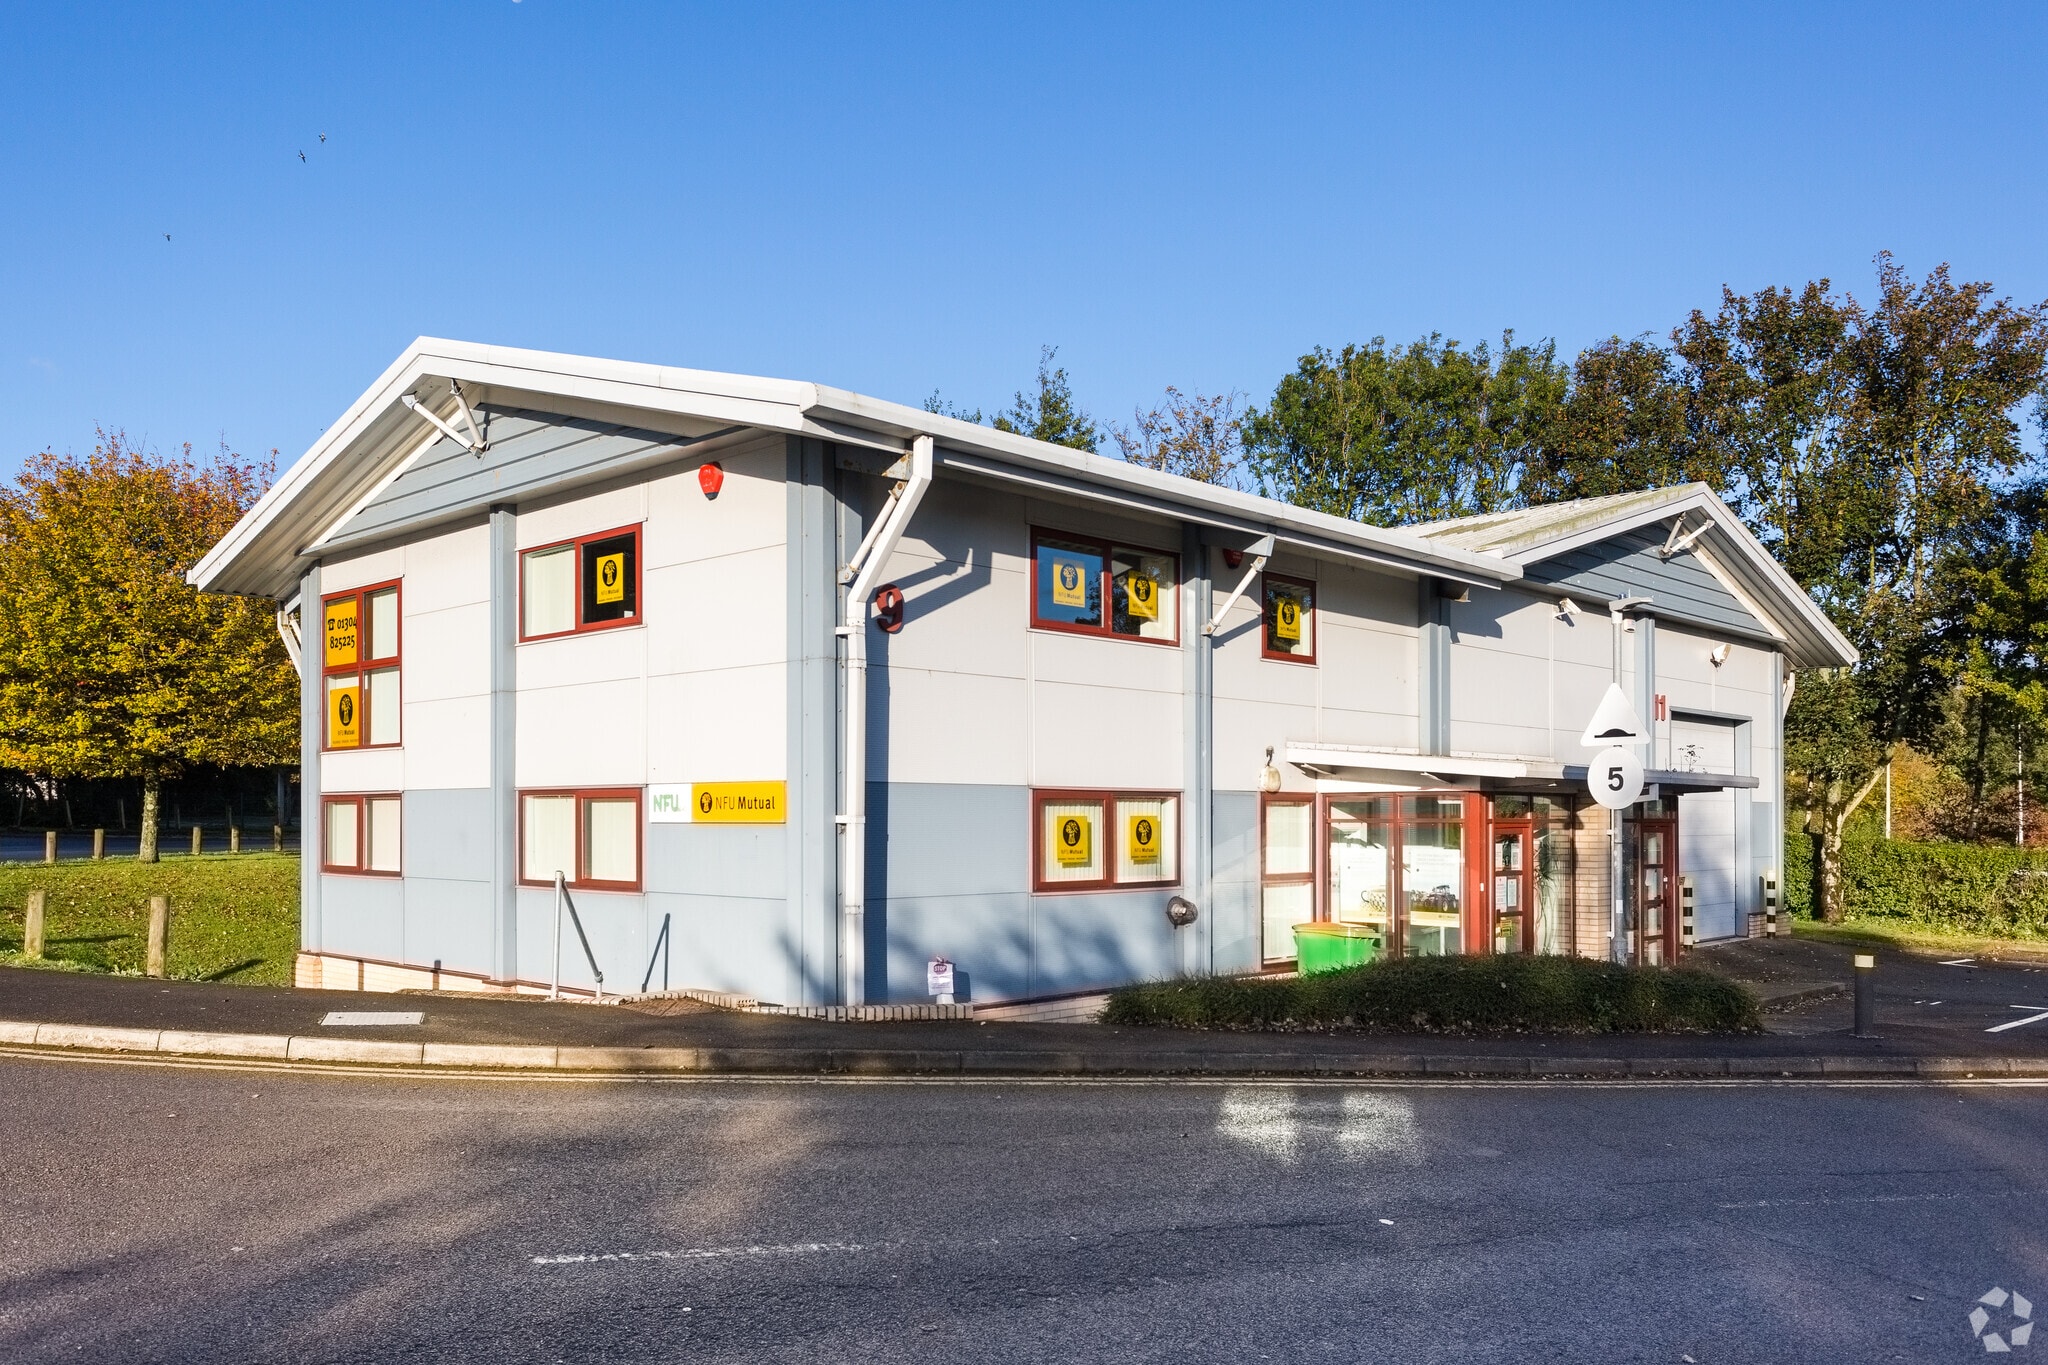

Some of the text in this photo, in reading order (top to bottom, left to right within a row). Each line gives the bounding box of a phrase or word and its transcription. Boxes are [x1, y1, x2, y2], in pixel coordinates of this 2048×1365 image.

[876, 583, 904, 634] 9
[337, 616, 357, 631] 01304
[330, 635, 355, 650] 825225
[1608, 766, 1624, 791] 5
[653, 794, 680, 812] NFU
[715, 796, 775, 809] NFU Mutual
